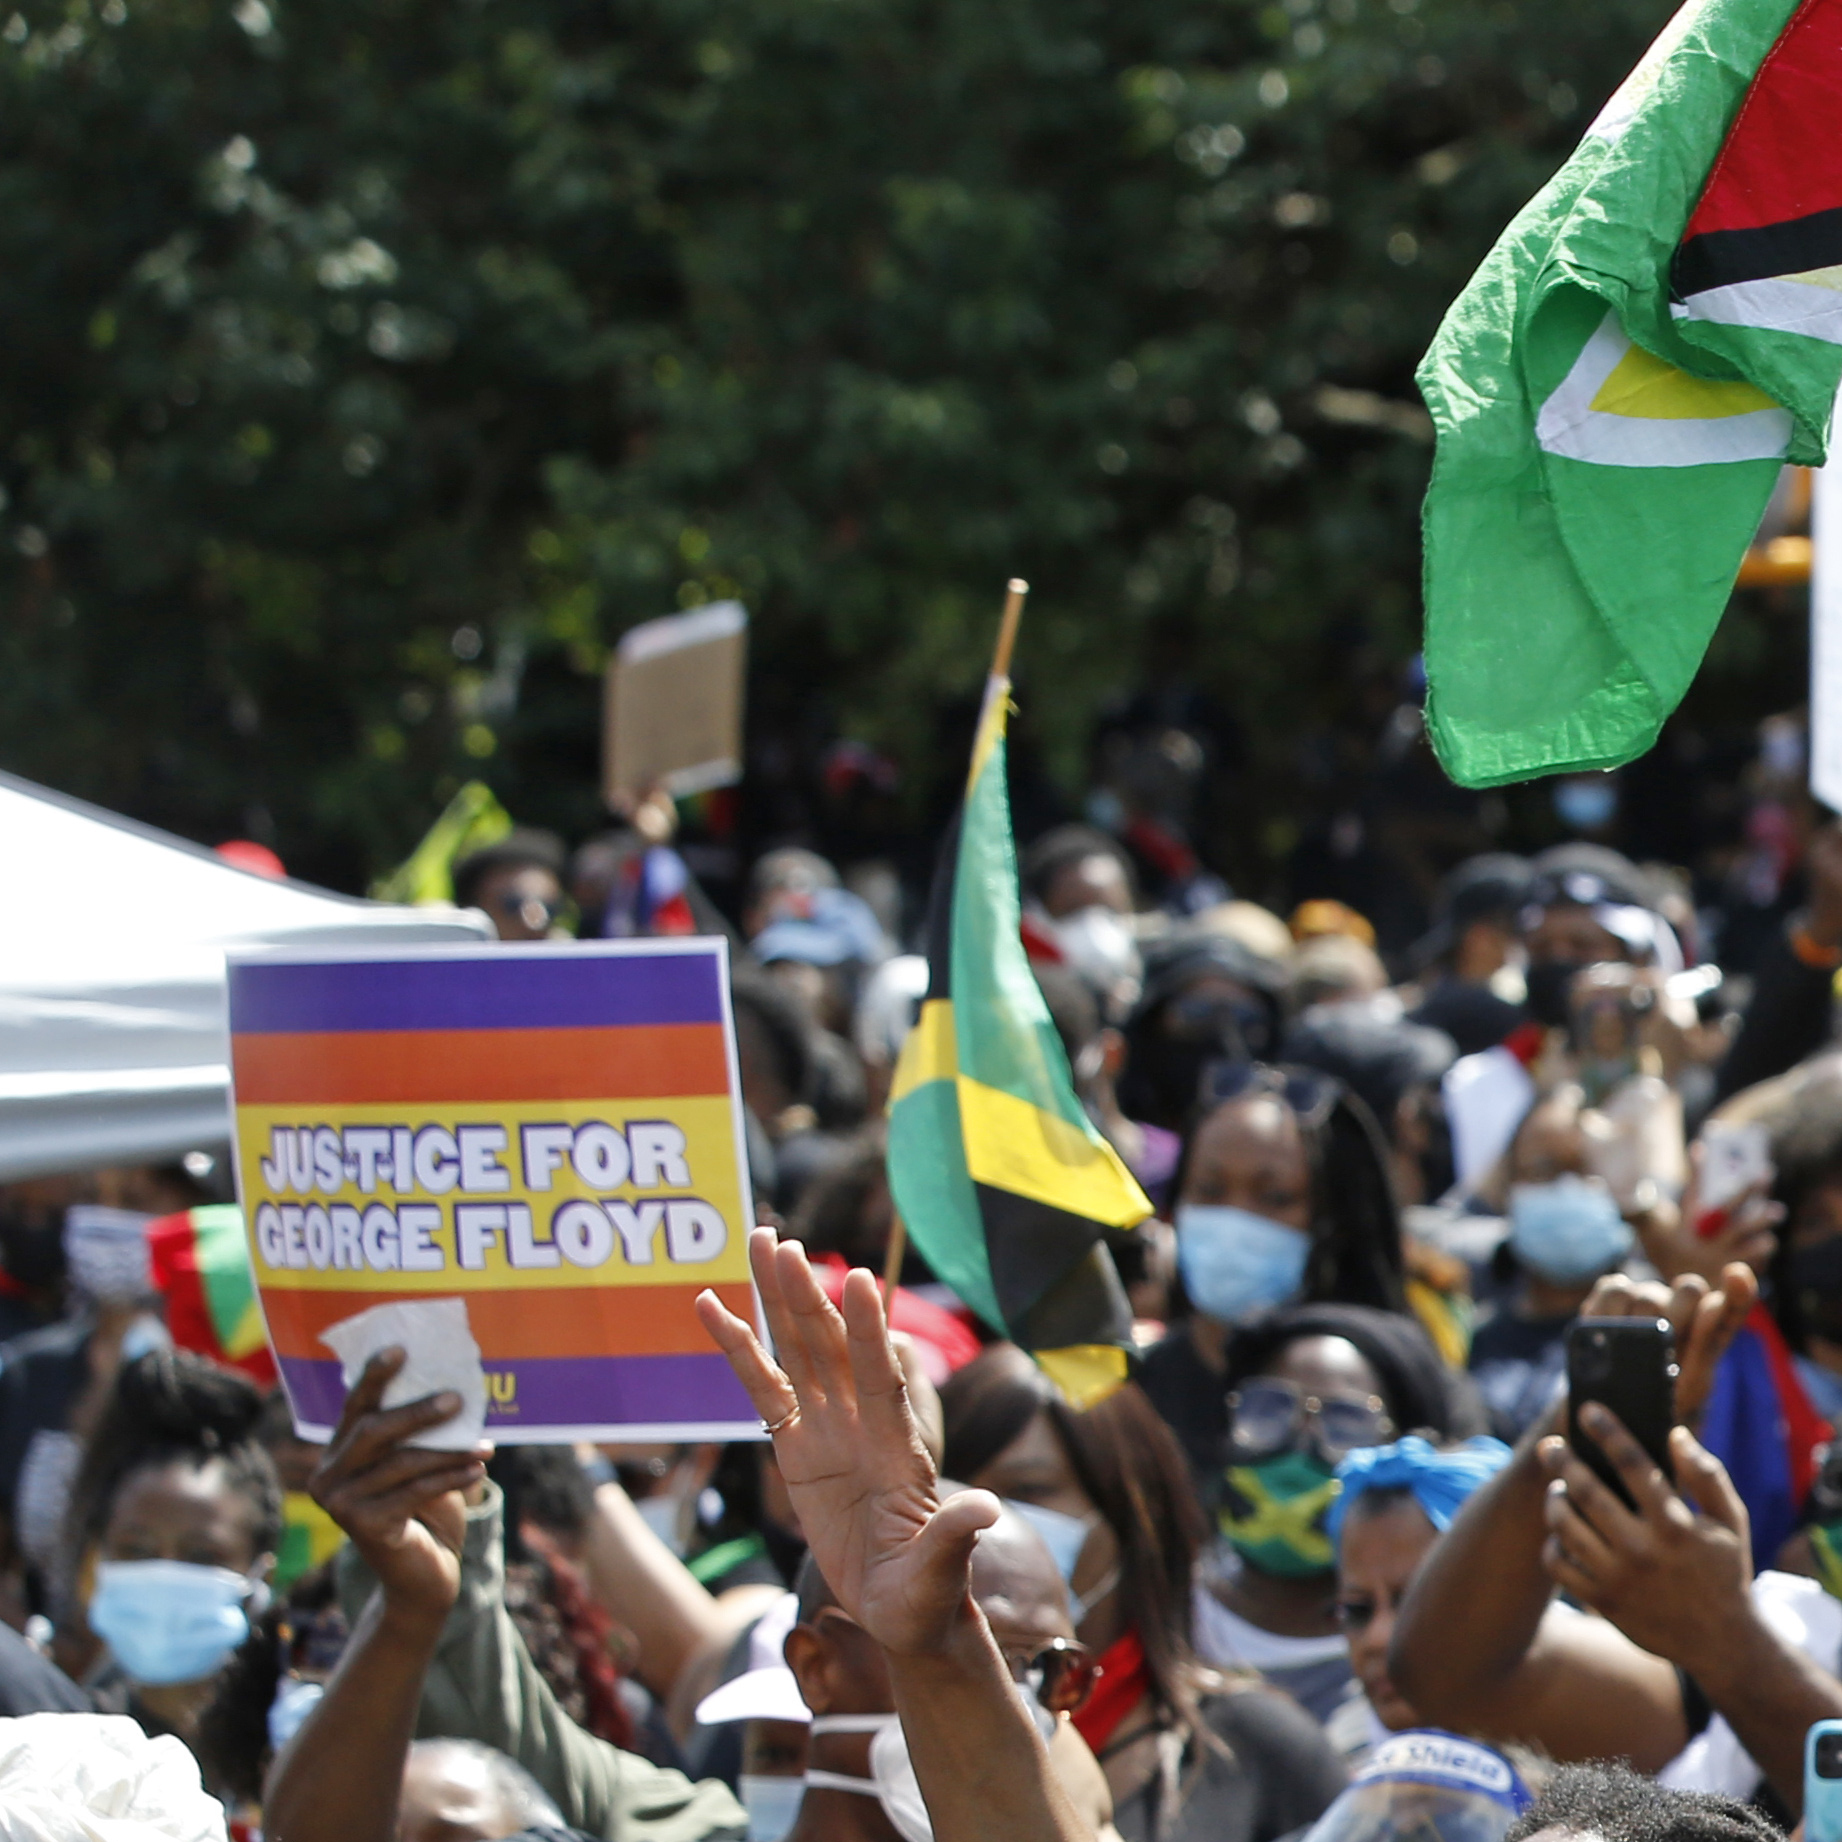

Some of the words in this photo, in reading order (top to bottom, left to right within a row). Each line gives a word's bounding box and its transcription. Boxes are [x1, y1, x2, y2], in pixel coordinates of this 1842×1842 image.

[260, 1124, 511, 1195] JUSTICE
[519, 1119, 693, 1191] FOR
[255, 1200, 446, 1273] GEORGE
[453, 1196, 728, 1269] FLOYD
